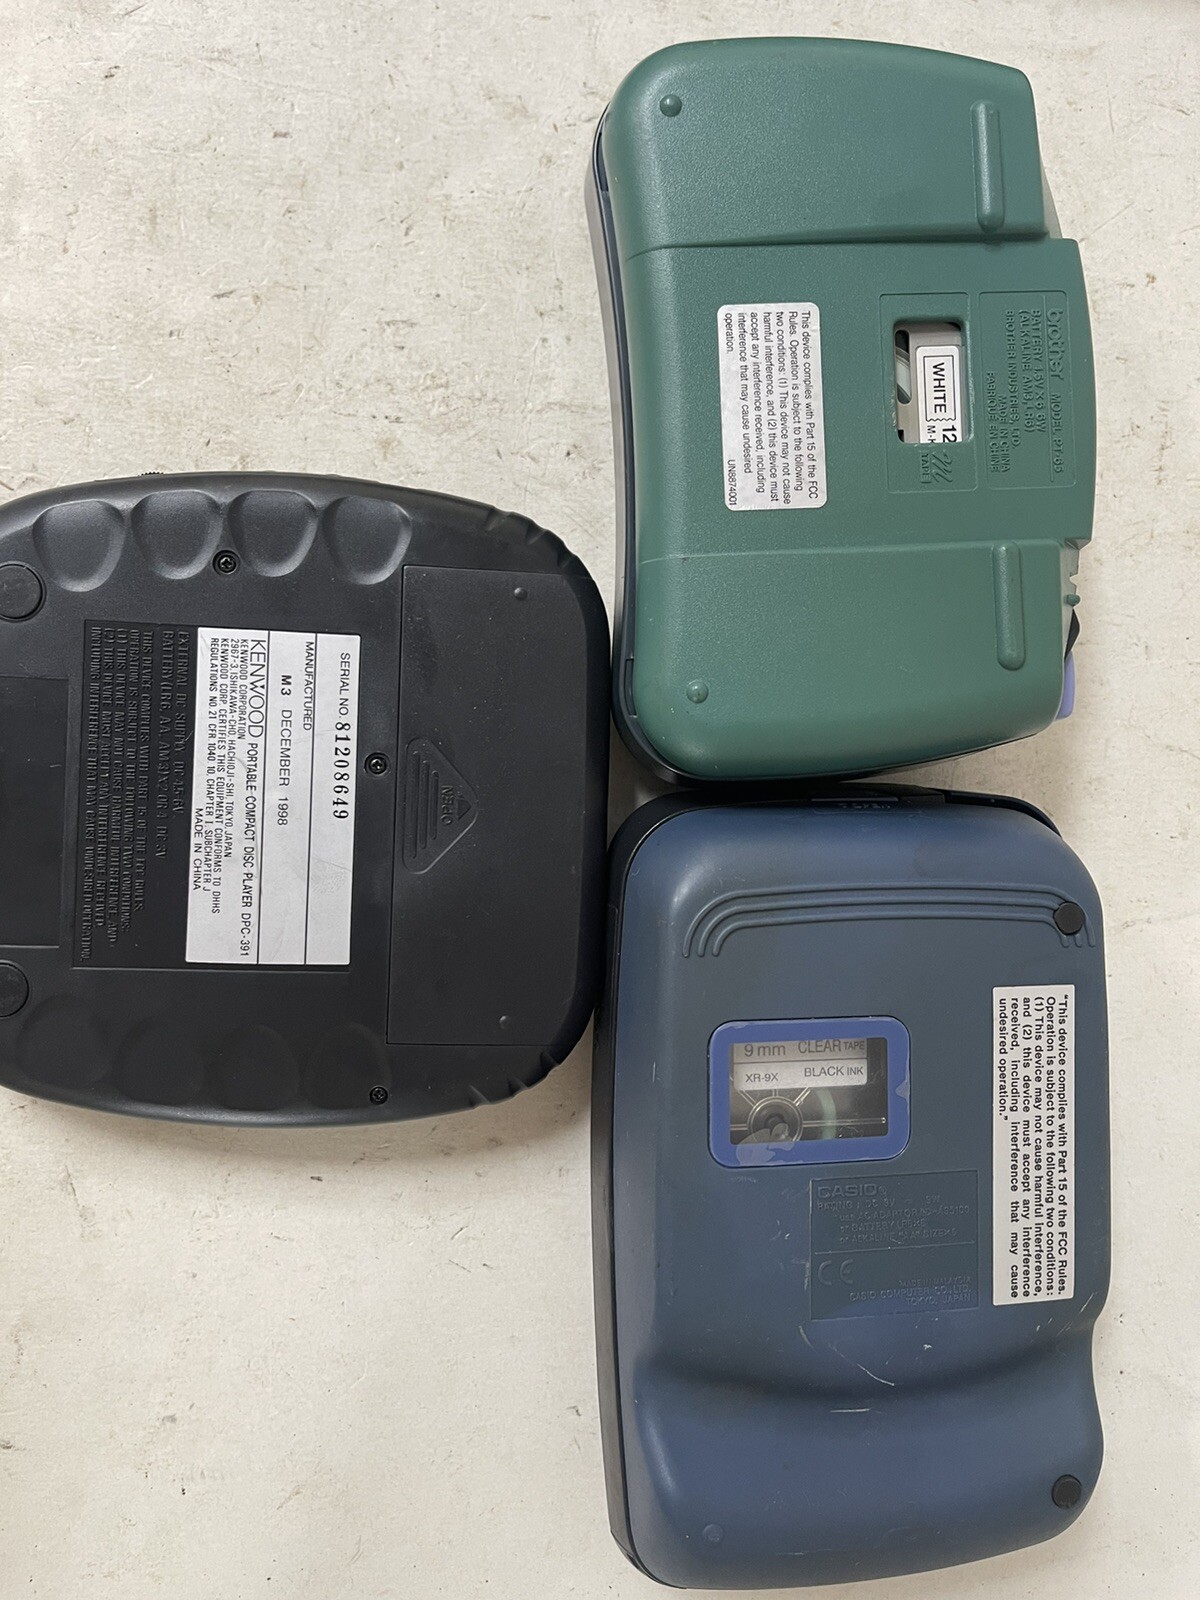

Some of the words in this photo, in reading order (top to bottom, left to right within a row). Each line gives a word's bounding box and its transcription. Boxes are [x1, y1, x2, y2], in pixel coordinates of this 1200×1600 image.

[723, 312, 734, 354] operation.
[749, 311, 760, 341] accept
[763, 311, 774, 343] harmful
[775, 311, 784, 327] two
[788, 311, 798, 337] Rules.
[801, 310, 811, 329] This
[1005, 309, 1015, 358] BROTHER
[737, 312, 748, 362] interference
[750, 343, 760, 360] any
[801, 331, 812, 360] device
[1045, 307, 1063, 380] brother
[776, 329, 786, 375] conditions:
[788, 339, 799, 381] Operation
[739, 364, 749, 382] that
[764, 345, 775, 397] interference,
[778, 377, 788, 388] (1)
[802, 361, 813, 400] complies
[739, 383, 749, 402] may
[752, 361, 763, 412] interference
[779, 390, 789, 409] This
[791, 383, 799, 391] is
[933, 362, 947, 414] WHITE
[741, 404, 750, 430] cause
[766, 400, 777, 416] and
[791, 393, 802, 424] subject
[805, 402, 814, 420] with
[997, 394, 1007, 422] MADE
[1050, 392, 1061, 433] MODEL
[754, 414, 765, 452] received,
[766, 418, 778, 431] (2)
[779, 411, 790, 440] device
[793, 426, 802, 436] to
[806, 422, 816, 439] Part
[943, 425, 957, 443] 12
[999, 428, 1008, 438] IN
[742, 432, 753, 474] undesired
[768, 432, 778, 448] this
[780, 442, 789, 460] may
[793, 437, 803, 451] the
[806, 442, 816, 451] 15
[768, 450, 779, 479] device
[782, 462, 791, 476] not
[807, 453, 817, 462] of
[921, 453, 931, 479] TAPE
[1000, 441, 1010, 473] CHINA
[1052, 437, 1063, 473] PT-65
[727, 459, 738, 506] UN8874001
[756, 455, 766, 493] including
[793, 454, 805, 491] following
[807, 464, 817, 478] the
[770, 481, 780, 502] must
[782, 478, 791, 505] cause
[808, 480, 819, 499] FCC
[209, 637, 220, 692] REGULATIONS
[219, 638, 230, 680] KENWOOD
[239, 639, 249, 681] KENWOOD
[339, 652, 351, 695] SERIAL
[247, 639, 267, 738] KENWOOD
[303, 641, 315, 731] MANUFACTURED
[208, 710, 217, 719] 21
[237, 684, 248, 740] CORPORATION
[217, 708, 227, 750] CERTIFIES
[279, 709, 293, 787] DECEMBER
[216, 754, 226, 773] THIS
[245, 742, 259, 791] PORTABLE
[332, 721, 351, 819] 81208649
[205, 778, 215, 816] CHAPTER
[215, 776, 225, 824] EQUIPMENT
[277, 797, 289, 826] 1998
[440, 786, 454, 826] OPEN
[194, 808, 204, 838] MADE
[244, 795, 257, 842] COMPACT
[194, 843, 202, 853] IN
[203, 829, 214, 884] SUBCHAPTER
[213, 828, 224, 873] CONFORMS
[223, 830, 233, 858] JAPAN
[242, 846, 255, 868] DISC
[193, 858, 202, 891] CHINA
[212, 877, 221, 887] TO
[211, 891, 221, 914] DHHS
[241, 872, 254, 908] PLAYER
[240, 913, 252, 956] DPC-391
[1022, 997, 1032, 1018] and
[1034, 996, 1044, 1012] (1)
[999, 998, 1009, 1055] undesired
[1009, 997, 1020, 1051] received,
[1022, 1024, 1033, 1040] (2)
[1034, 1016, 1044, 1041] This
[1045, 996, 1056, 1052] Operation
[744, 1043, 753, 1057] 9
[757, 1044, 785, 1056] mm
[797, 1038, 841, 1054] CLEAR
[843, 1040, 865, 1050] TAPE
[1022, 1047, 1033, 1069] this
[1046, 1055, 1056, 1066] is
[1058, 1027, 1068, 1066] device
[745, 1072, 779, 1083] XR-9X
[804, 1065, 845, 1078] BLACK
[846, 1066, 864, 1076] INK
[1034, 1045, 1044, 1083] device
[1009, 1060, 1020, 1112] including
[1022, 1075, 1033, 1113] device
[1033, 1087, 1042, 1110] may
[1045, 1069, 1056, 1111] subject
[1057, 1069, 1068, 1120] complies
[1022, 1120, 1032, 1147] must
[1034, 1115, 1043, 1133] not
[1046, 1114, 1055, 1127] to
[1058, 1123, 1068, 1147] with
[1046, 1130, 1056, 1148] the
[1010, 1121, 1020, 1192] interference
[1034, 1137, 1042, 1171] cause
[1058, 1150, 1068, 1174] Part
[1021, 1153, 1032, 1193] accept
[1044, 1152, 1056, 1204] following
[1058, 1177, 1068, 1191] 15
[1021, 1199, 1030, 1220] any
[1034, 1175, 1044, 1218] harmful
[1058, 1194, 1068, 1206] of
[1010, 1200, 1020, 1223] that
[1046, 1207, 1055, 1228] two
[1058, 1209, 1068, 1228] the
[1009, 1232, 1018, 1255] may
[1058, 1231, 1068, 1256] FCC
[1022, 1226, 1033, 1297] interference
[1033, 1222, 1044, 1296] interference,
[1046, 1231, 1056, 1296] conditions:
[1010, 1264, 1019, 1298] cause
[1058, 1259, 1068, 1295] Rules.
